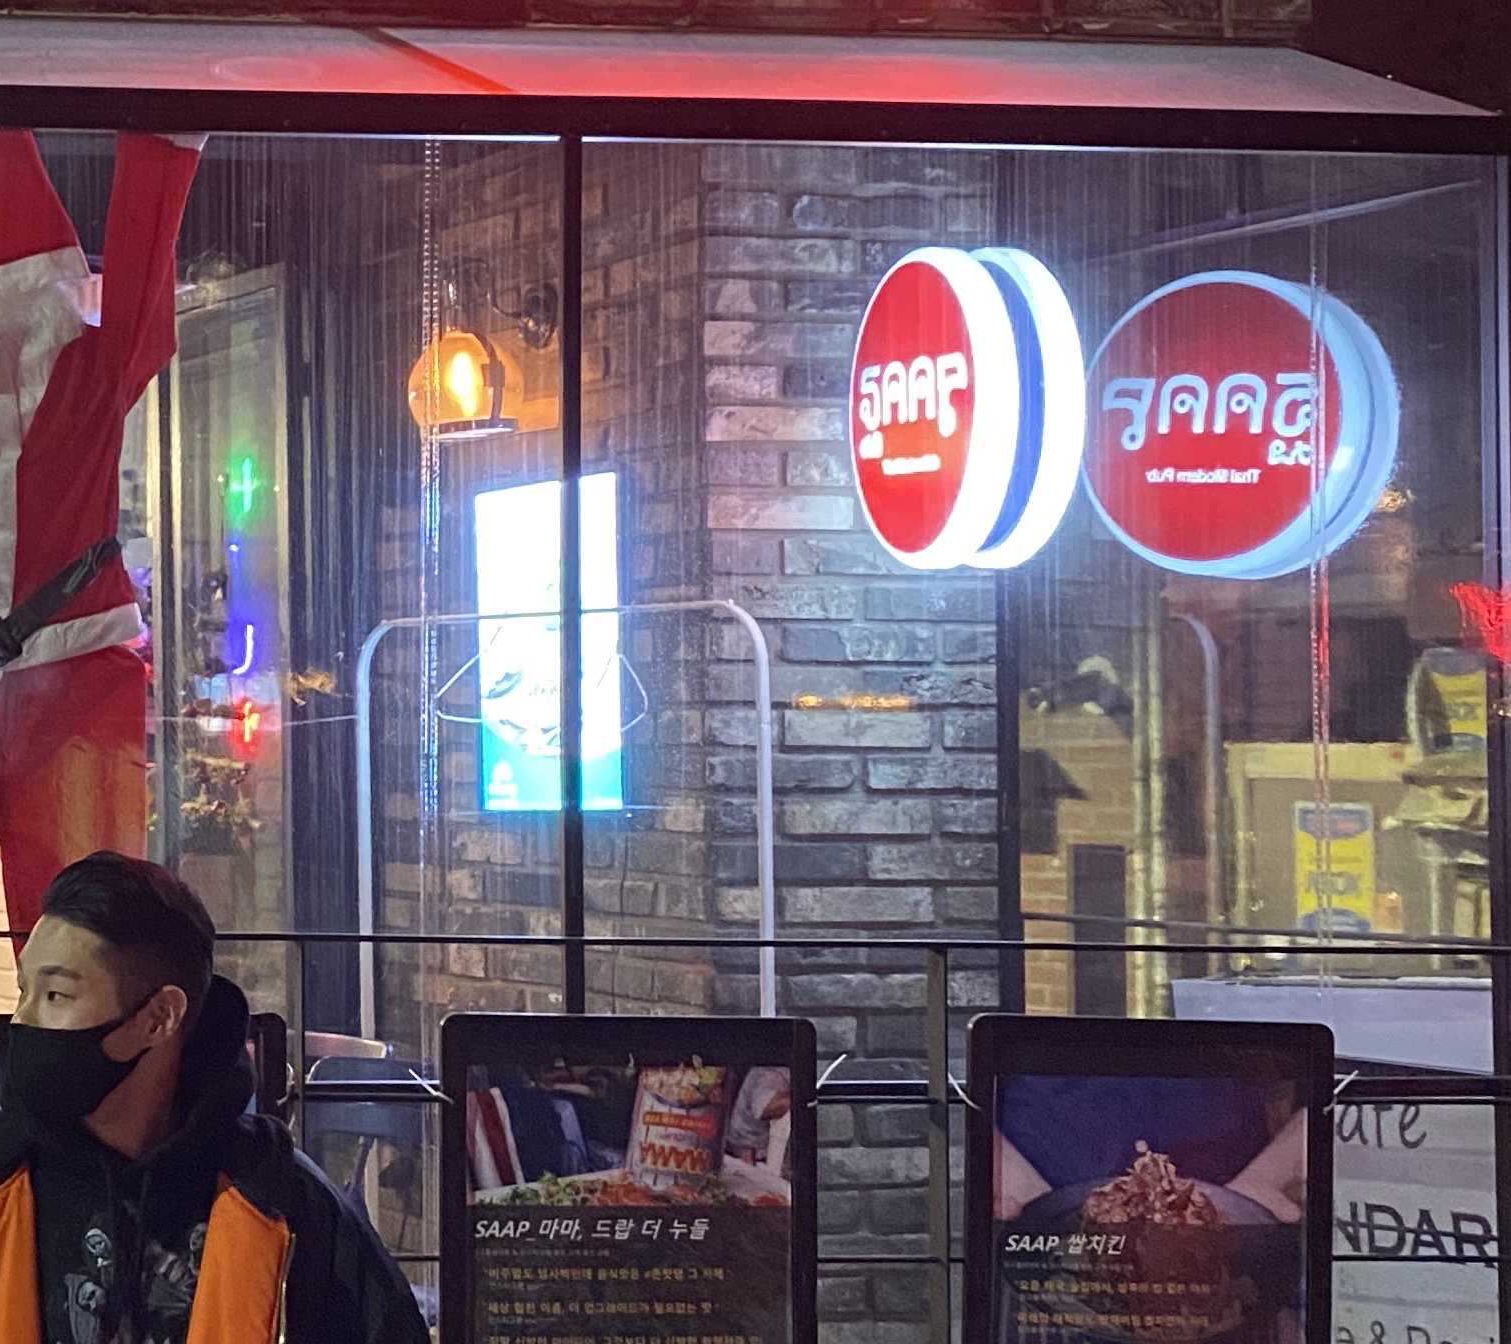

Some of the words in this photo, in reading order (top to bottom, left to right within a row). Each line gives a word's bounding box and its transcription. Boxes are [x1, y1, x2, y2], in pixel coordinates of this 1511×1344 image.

[591, 1218, 635, 1240] 드랍
[641, 1218, 662, 1240] 더
[668, 1218, 710, 1240] 누들
